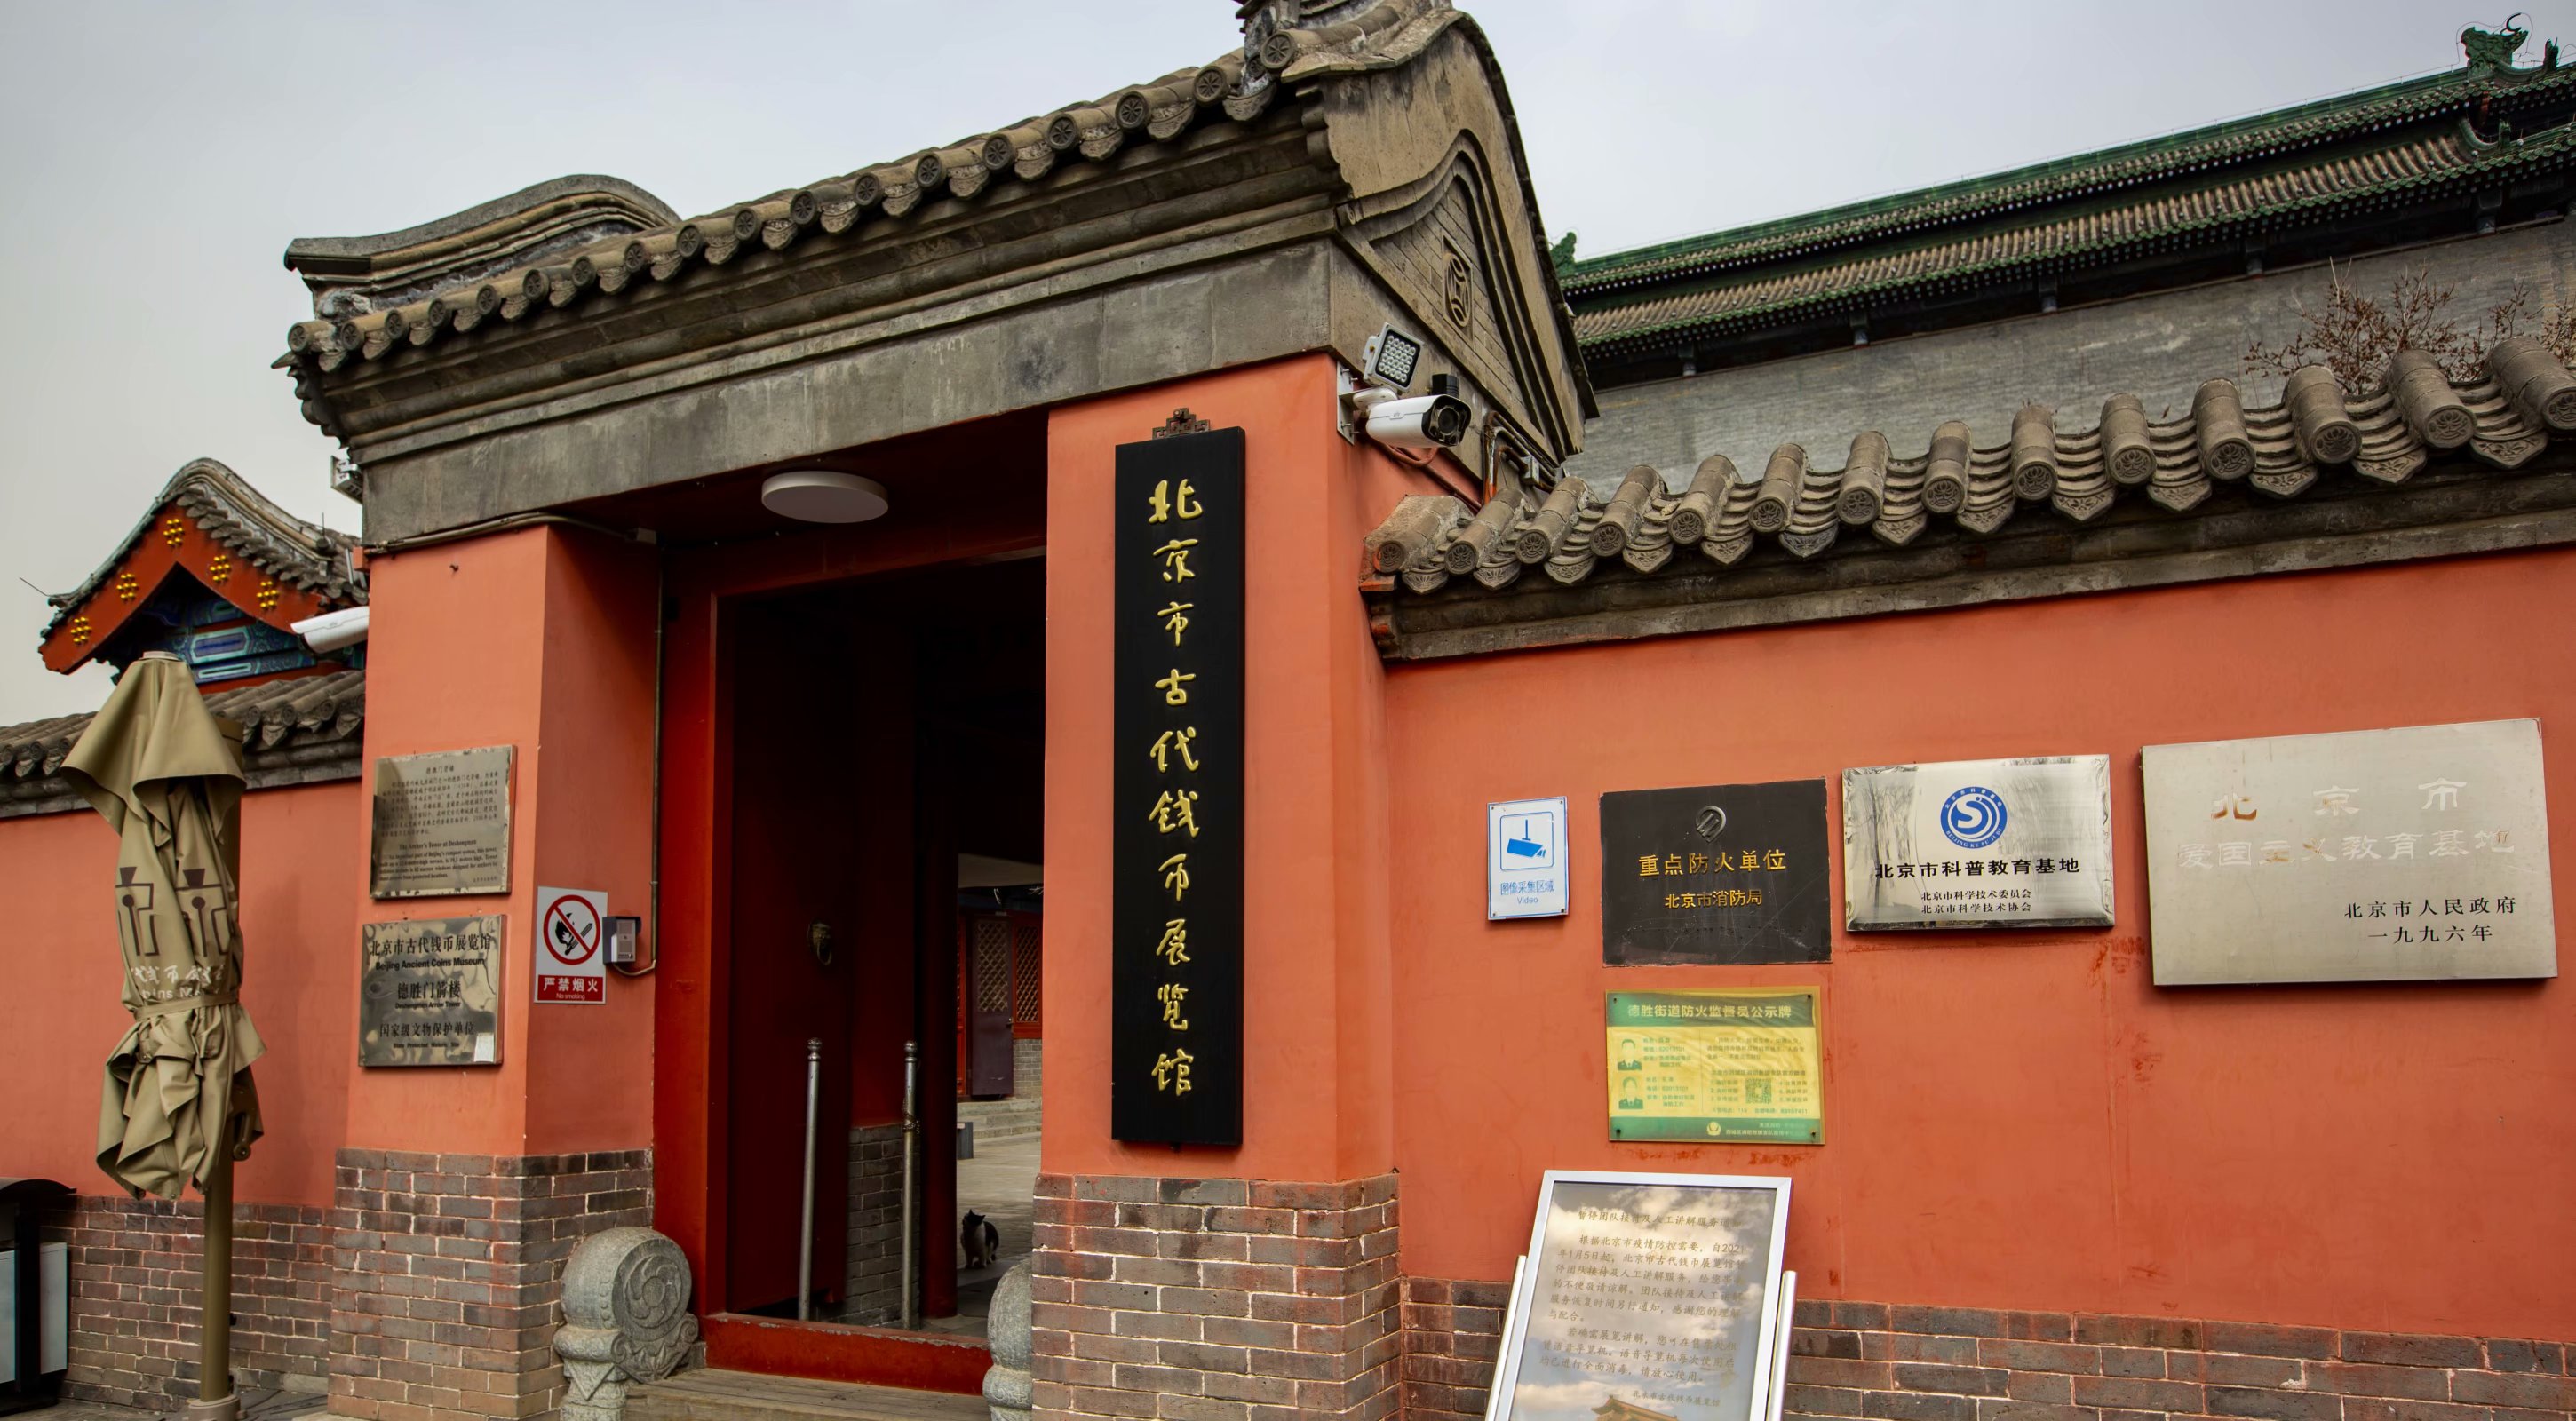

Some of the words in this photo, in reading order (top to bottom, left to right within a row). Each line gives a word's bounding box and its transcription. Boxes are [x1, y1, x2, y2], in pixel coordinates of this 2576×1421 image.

[1149, 479, 1203, 1096] 北京市古代钱币展览馆
[2211, 776, 2467, 821] 北京市
[2177, 826, 2515, 869] 爱国主义教育基地
[1638, 849, 1786, 877] 重点防火单位
[1875, 857, 2080, 879] 北京市科普教育基地
[1500, 879, 1554, 896] 图像采集区域
[1921, 888, 2031, 901] 北京市科学技术委员会
[1665, 889, 1763, 909] 北京市消防局
[1921, 901, 2031, 914] 北京市科学技术协会
[2344, 896, 2516, 919] 北京市人民政府
[2368, 924, 2493, 944] 一九九六年
[370, 933, 492, 957] 北京市古代钱币展览馆
[376, 960, 400, 972] Beijing
[402, 958, 429, 969] Ancient
[431, 958, 451, 967] Coins
[453, 957, 484, 965] Museum
[397, 980, 462, 1000] 德胜门箭楼
[544, 977, 598, 992] 严禁烟火
[395, 1002, 428, 1011] Deshengmen
[379, 1021, 475, 1038] 国家级文物保护单位
